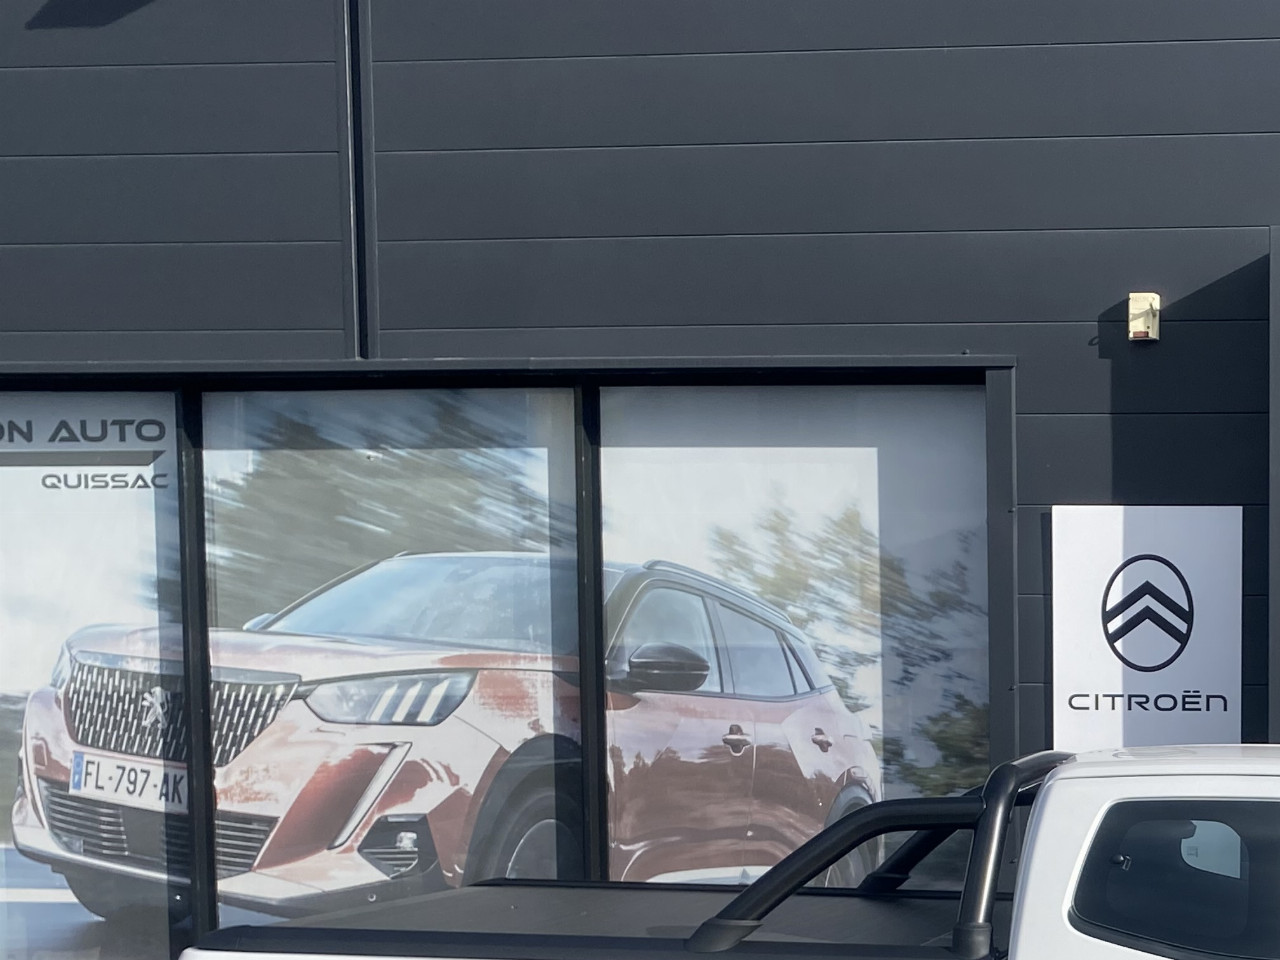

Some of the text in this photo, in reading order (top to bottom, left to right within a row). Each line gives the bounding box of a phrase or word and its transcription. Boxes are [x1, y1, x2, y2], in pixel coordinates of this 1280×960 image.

[0, 419, 166, 443] N AUTO
[41, 473, 169, 489] QUISSAC
